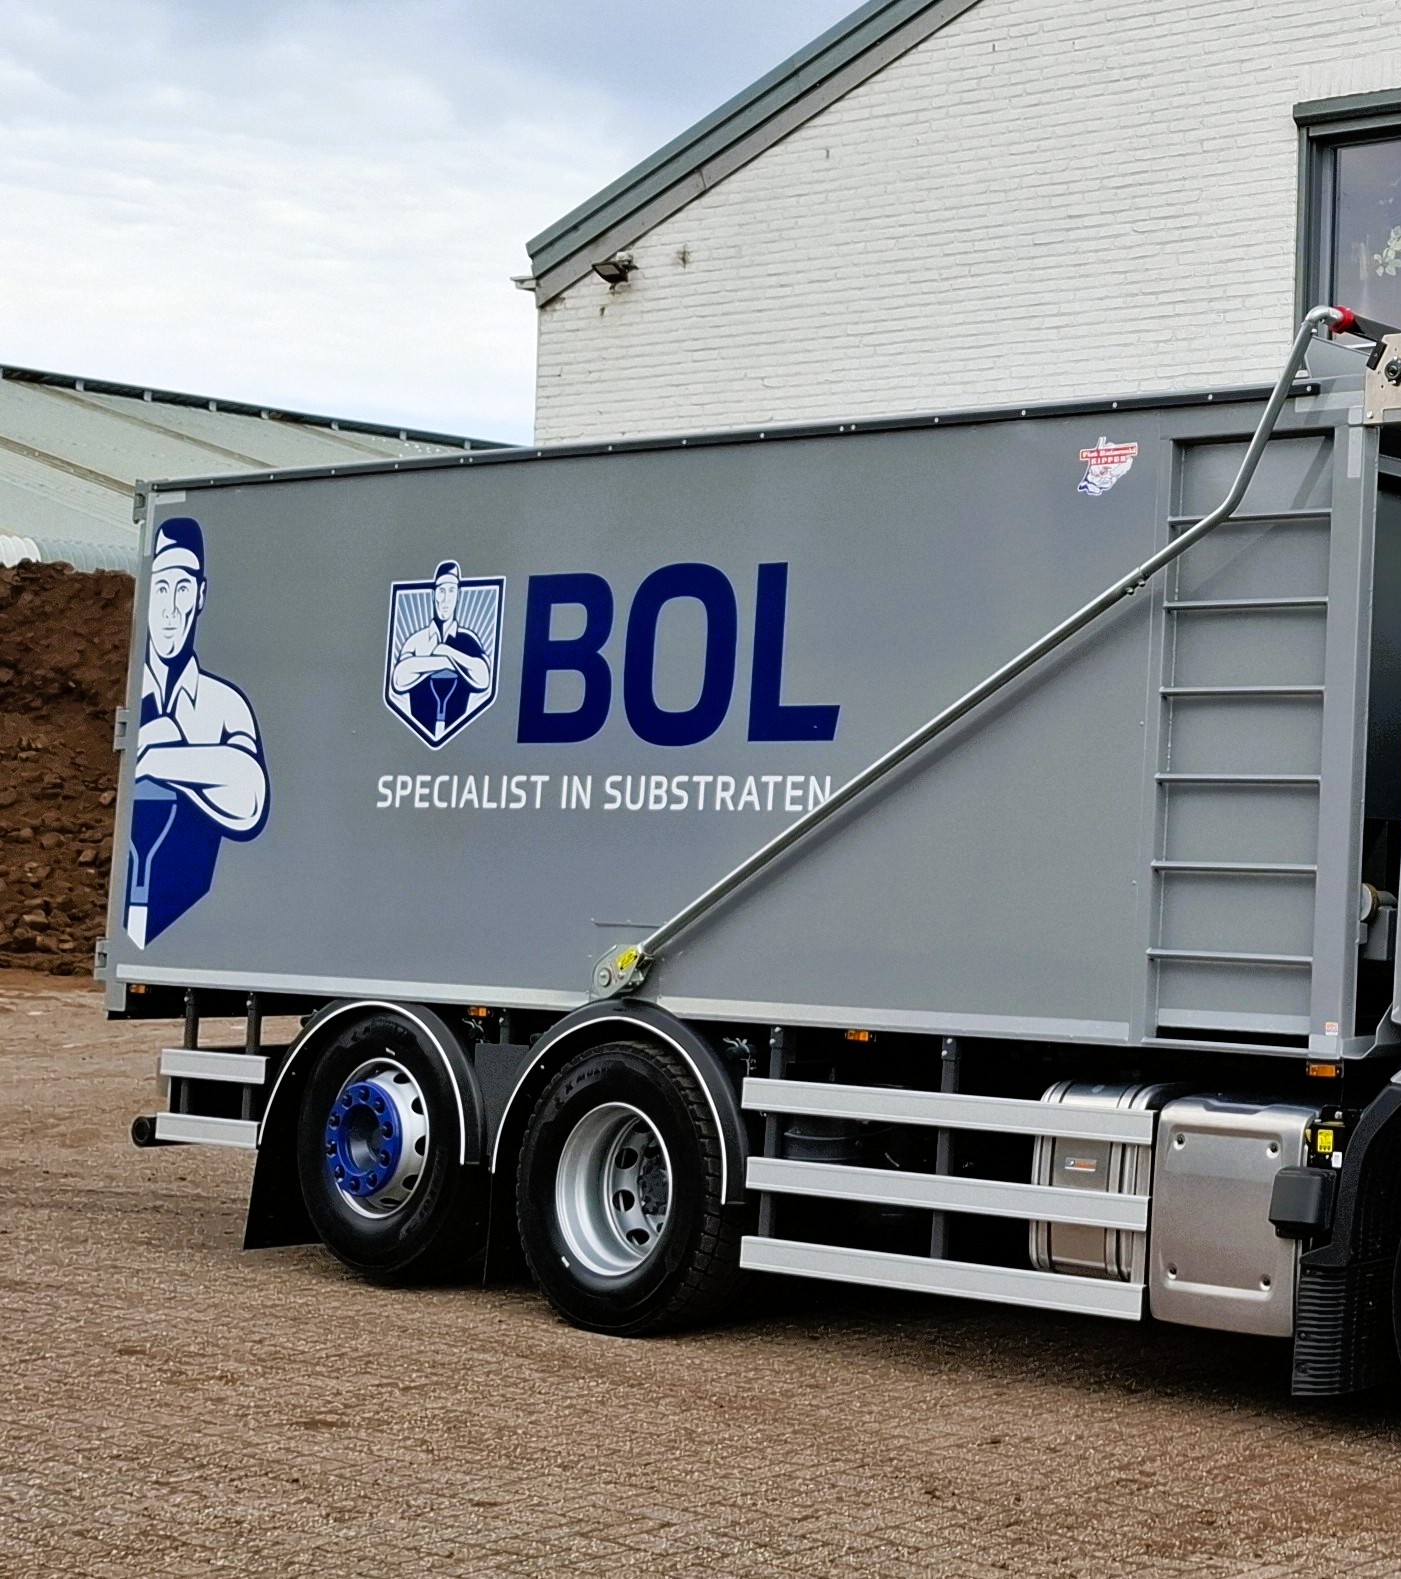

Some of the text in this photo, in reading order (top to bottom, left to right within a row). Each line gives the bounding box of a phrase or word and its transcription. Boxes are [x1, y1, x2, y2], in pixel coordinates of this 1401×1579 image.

[516, 561, 841, 747] BOL
[376, 774, 832, 812] SPECIALIST IN SUBSTRATEN
